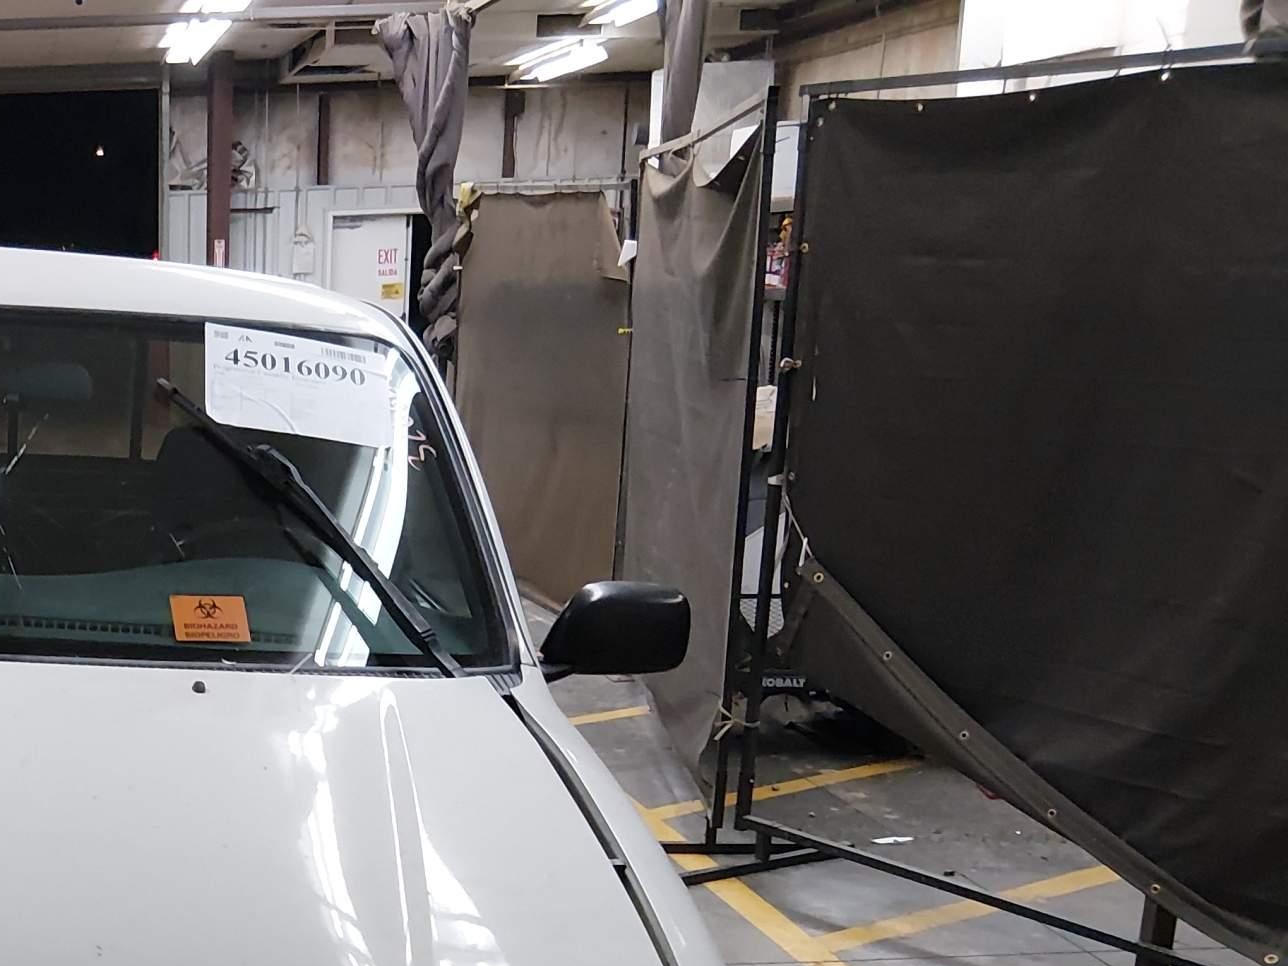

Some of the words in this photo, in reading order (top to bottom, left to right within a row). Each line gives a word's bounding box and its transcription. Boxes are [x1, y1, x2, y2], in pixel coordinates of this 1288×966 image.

[378, 248, 399, 265] EXIT
[378, 268, 398, 277] SALIDA
[224, 348, 366, 386] 45016090
[183, 622, 239, 631] BIOHAZARD
